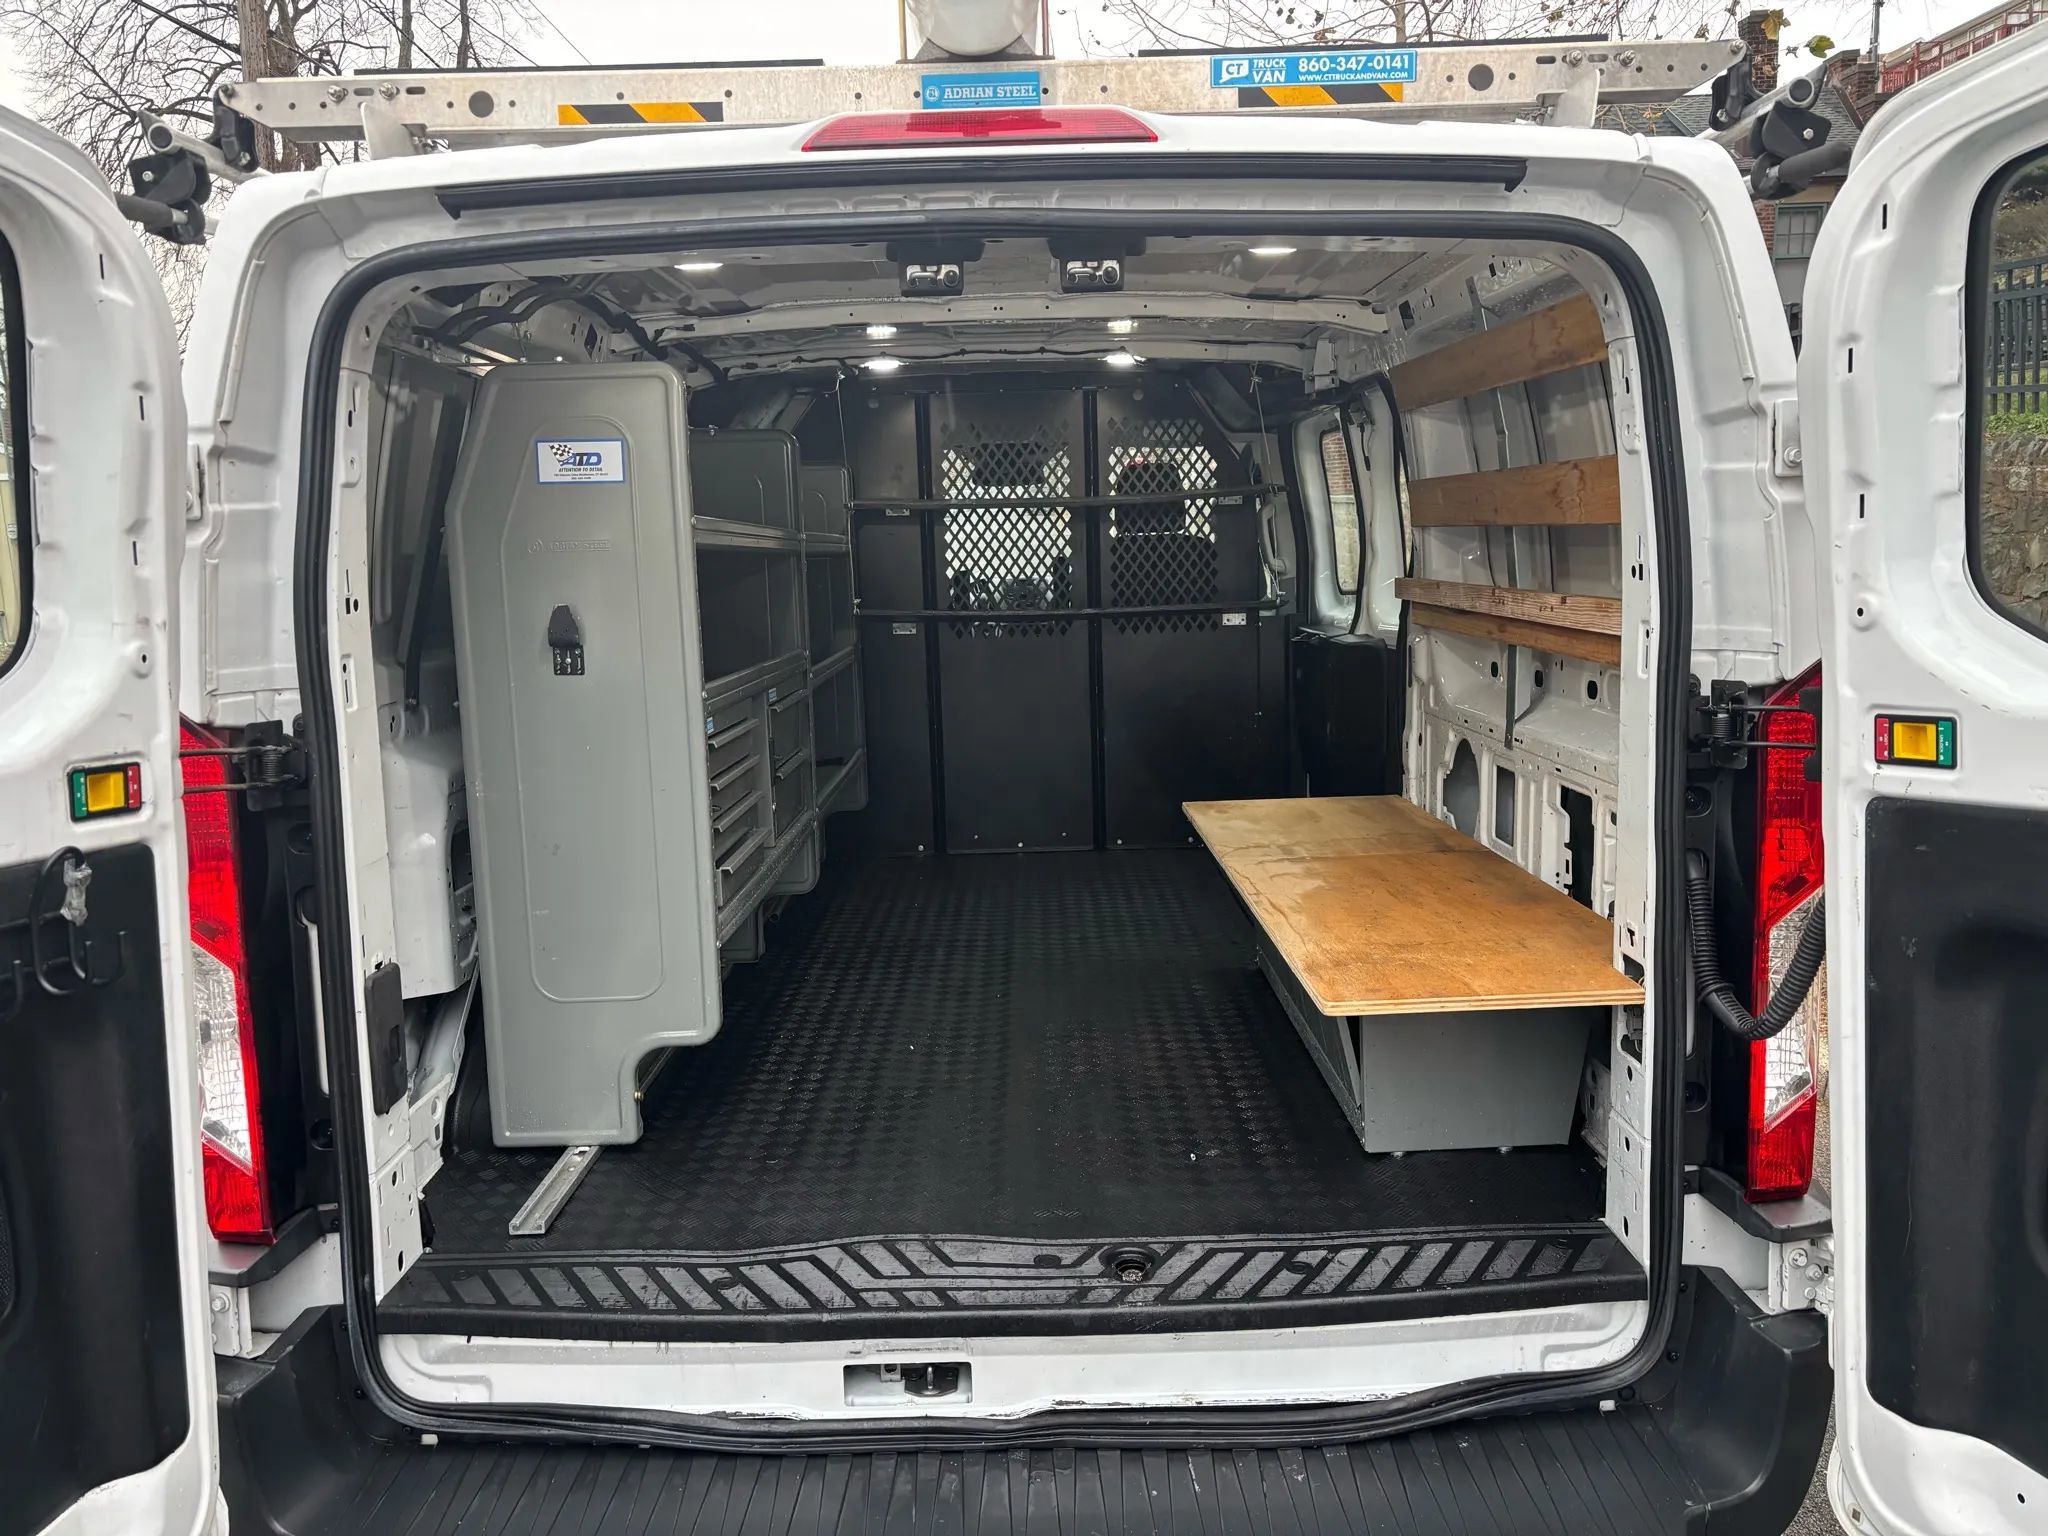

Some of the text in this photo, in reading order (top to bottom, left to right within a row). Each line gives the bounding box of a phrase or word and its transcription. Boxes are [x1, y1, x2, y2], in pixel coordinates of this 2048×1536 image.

[1225, 62, 1243, 75] CT
[1252, 58, 1286, 68] TRUCK
[1298, 54, 1409, 73] 860-347-0141
[1252, 69, 1286, 83] VAN
[1298, 71, 1409, 82] WWW.CTTRUCKANDVAN.COM
[944, 85, 1037, 99] ADRIAN STEEL
[560, 452, 602, 467] ATD
